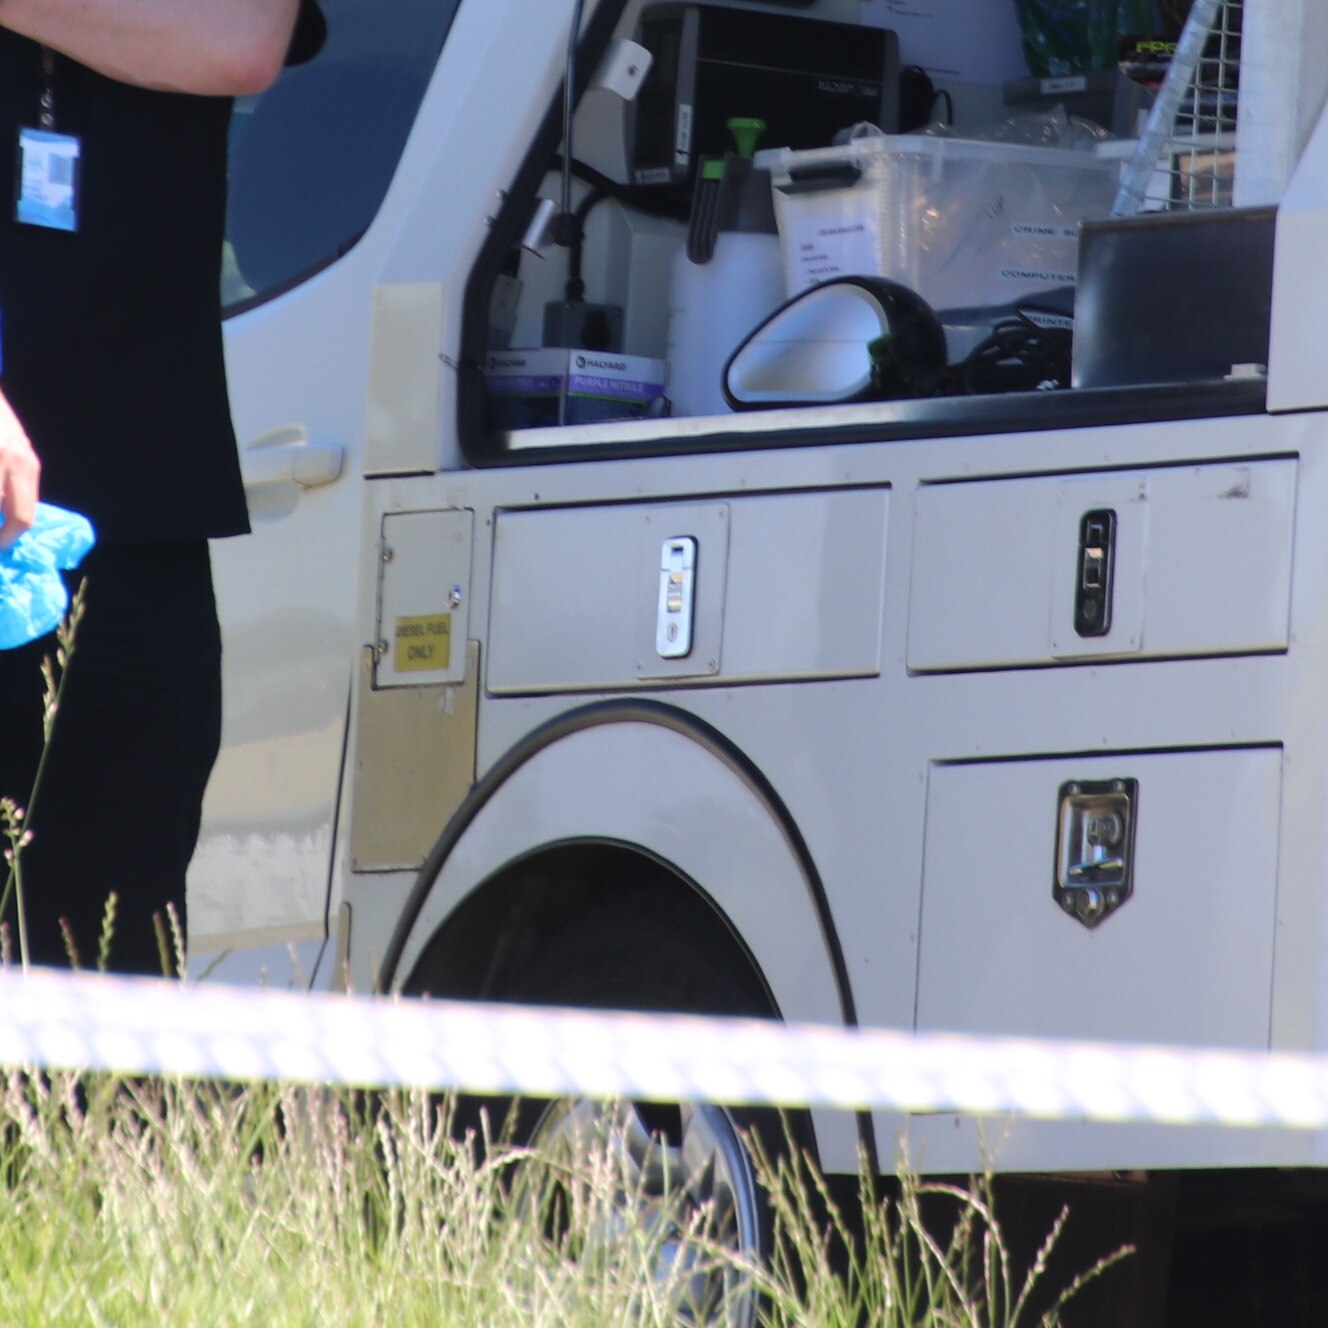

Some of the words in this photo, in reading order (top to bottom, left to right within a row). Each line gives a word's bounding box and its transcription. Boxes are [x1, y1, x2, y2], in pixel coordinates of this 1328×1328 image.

[1014, 225, 1054, 235] CRIME
[1001, 269, 1075, 281] COMPUTER
[587, 359, 626, 371] HALYARD
[575, 376, 610, 389] PURPLE
[396, 624, 425, 638] DIESEL
[427, 622, 448, 635] FUEL
[407, 644, 434, 660] ONLY
